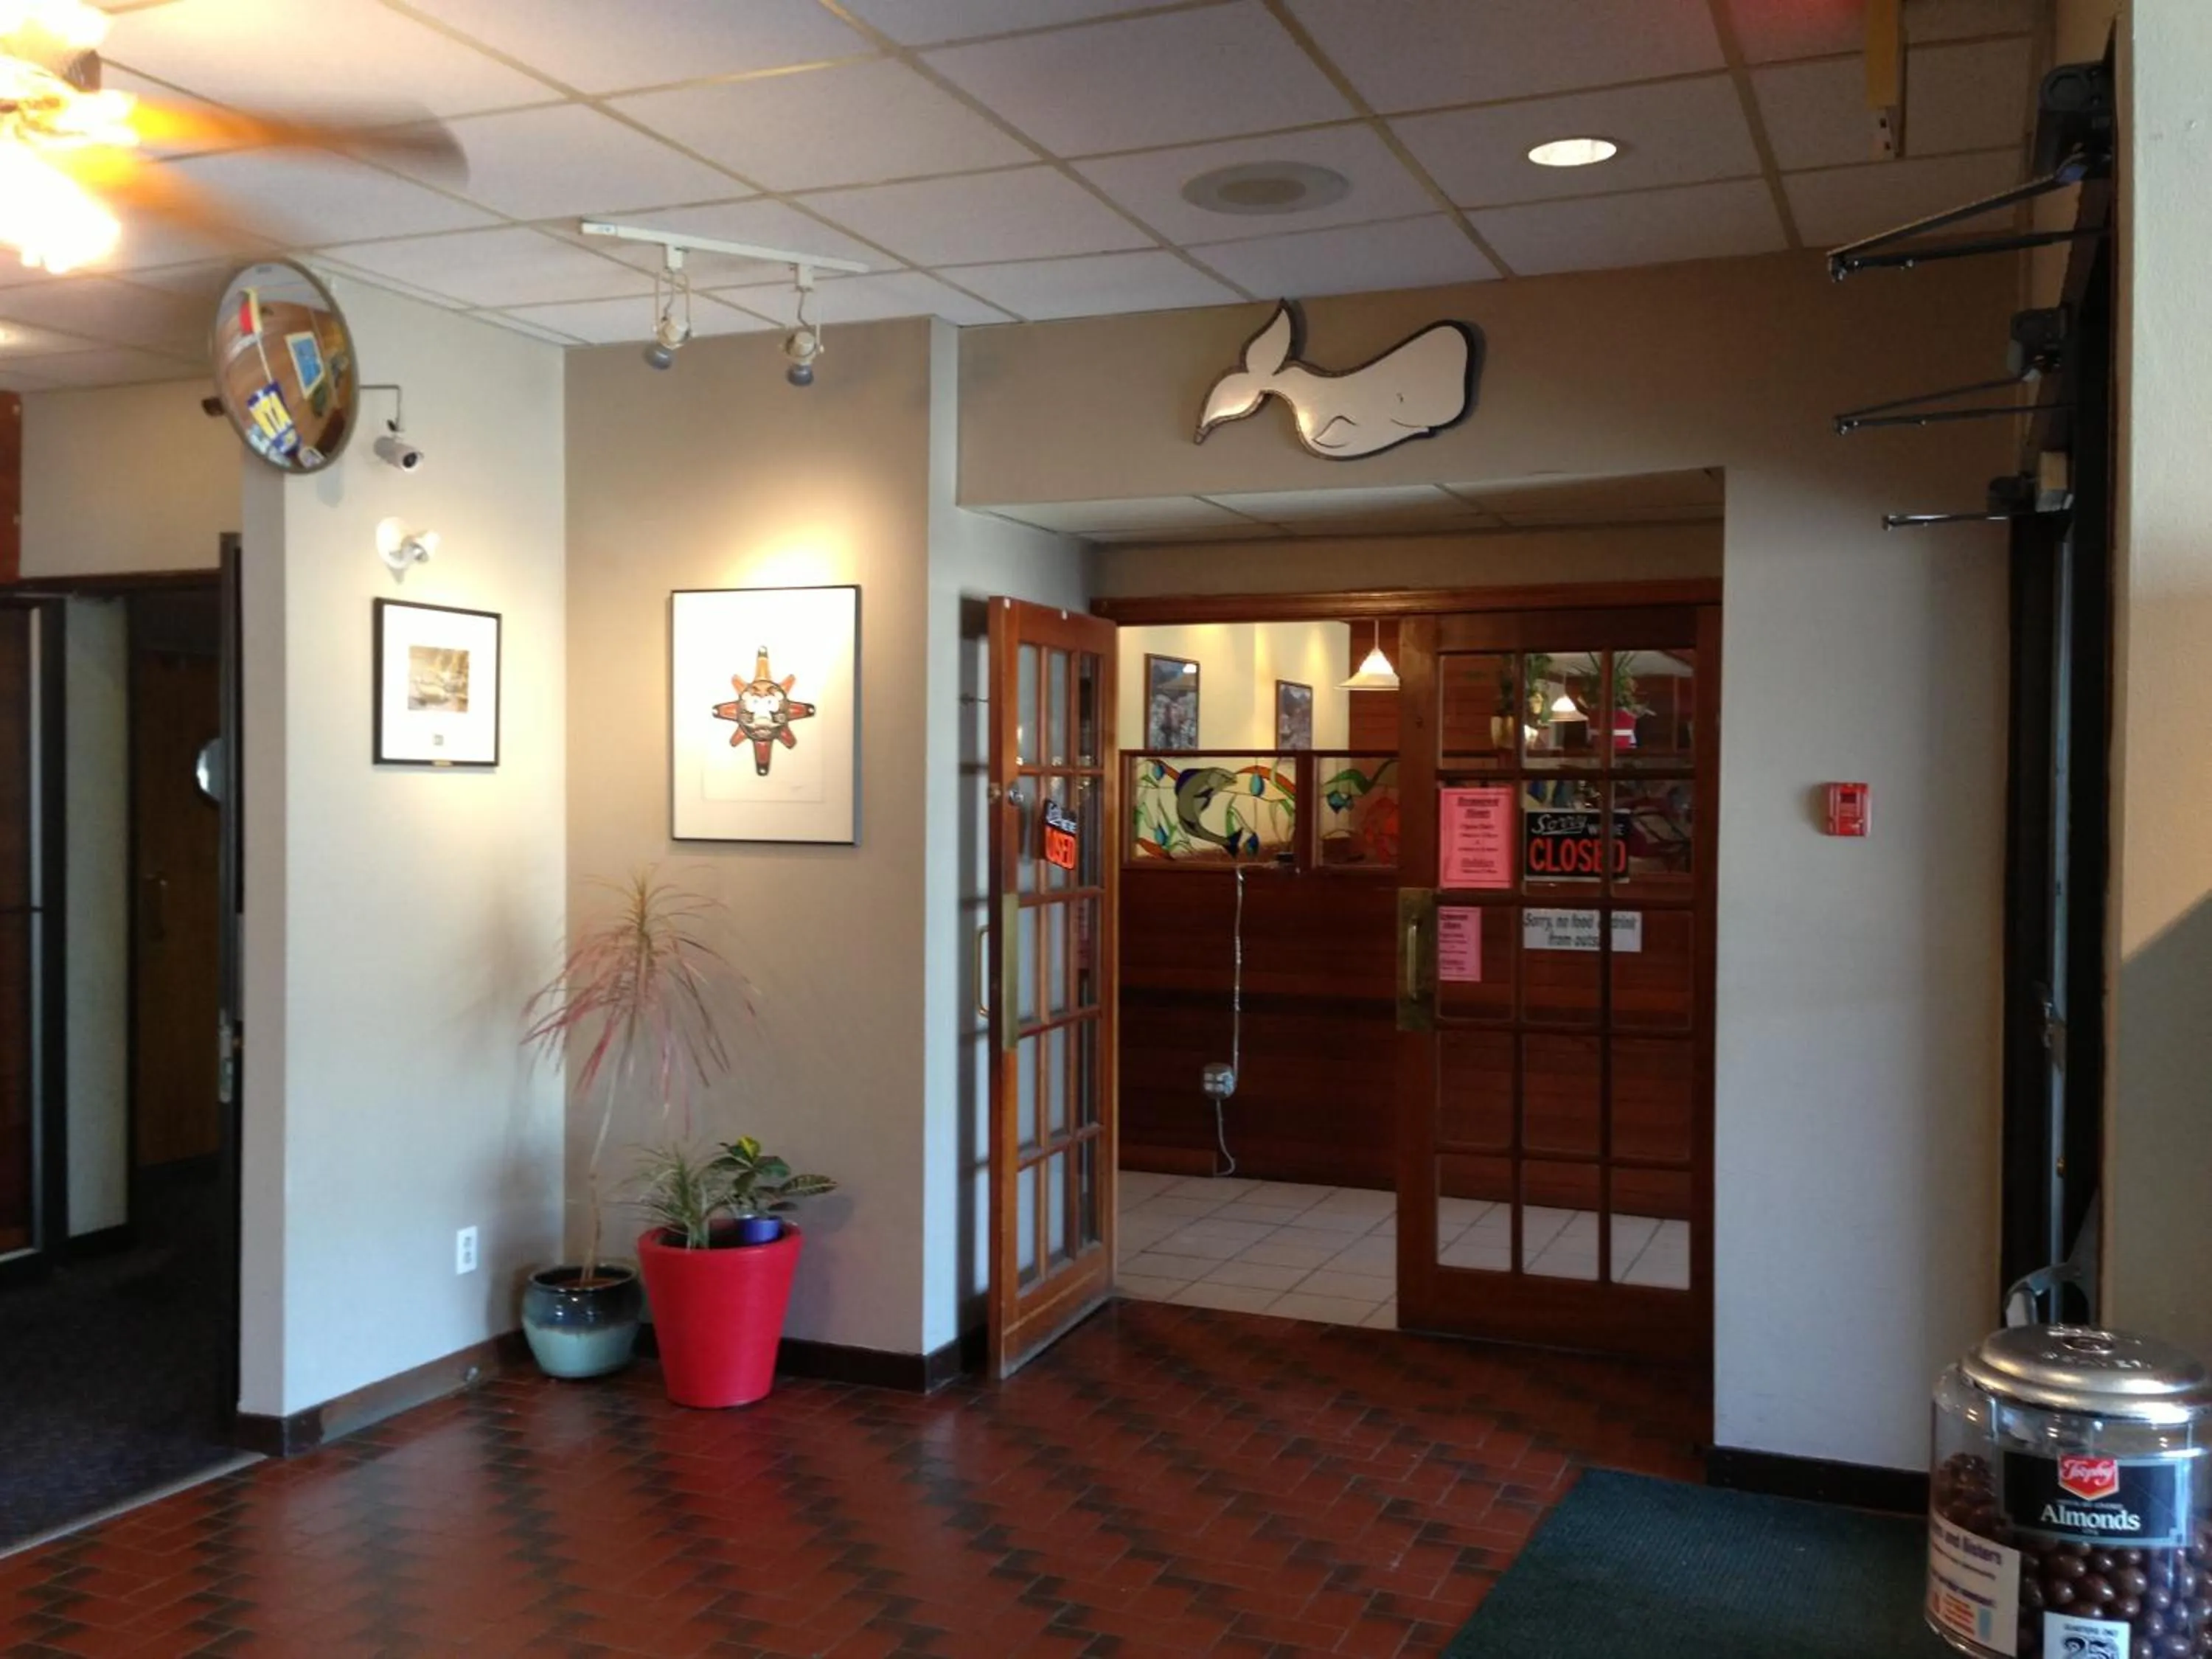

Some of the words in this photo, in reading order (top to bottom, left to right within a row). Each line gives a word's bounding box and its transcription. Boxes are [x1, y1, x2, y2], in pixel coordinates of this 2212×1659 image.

[1531, 813, 1587, 835] Sorry
[1529, 838, 1627, 872] CLOSED
[2040, 1504, 2141, 1531] Almonds
